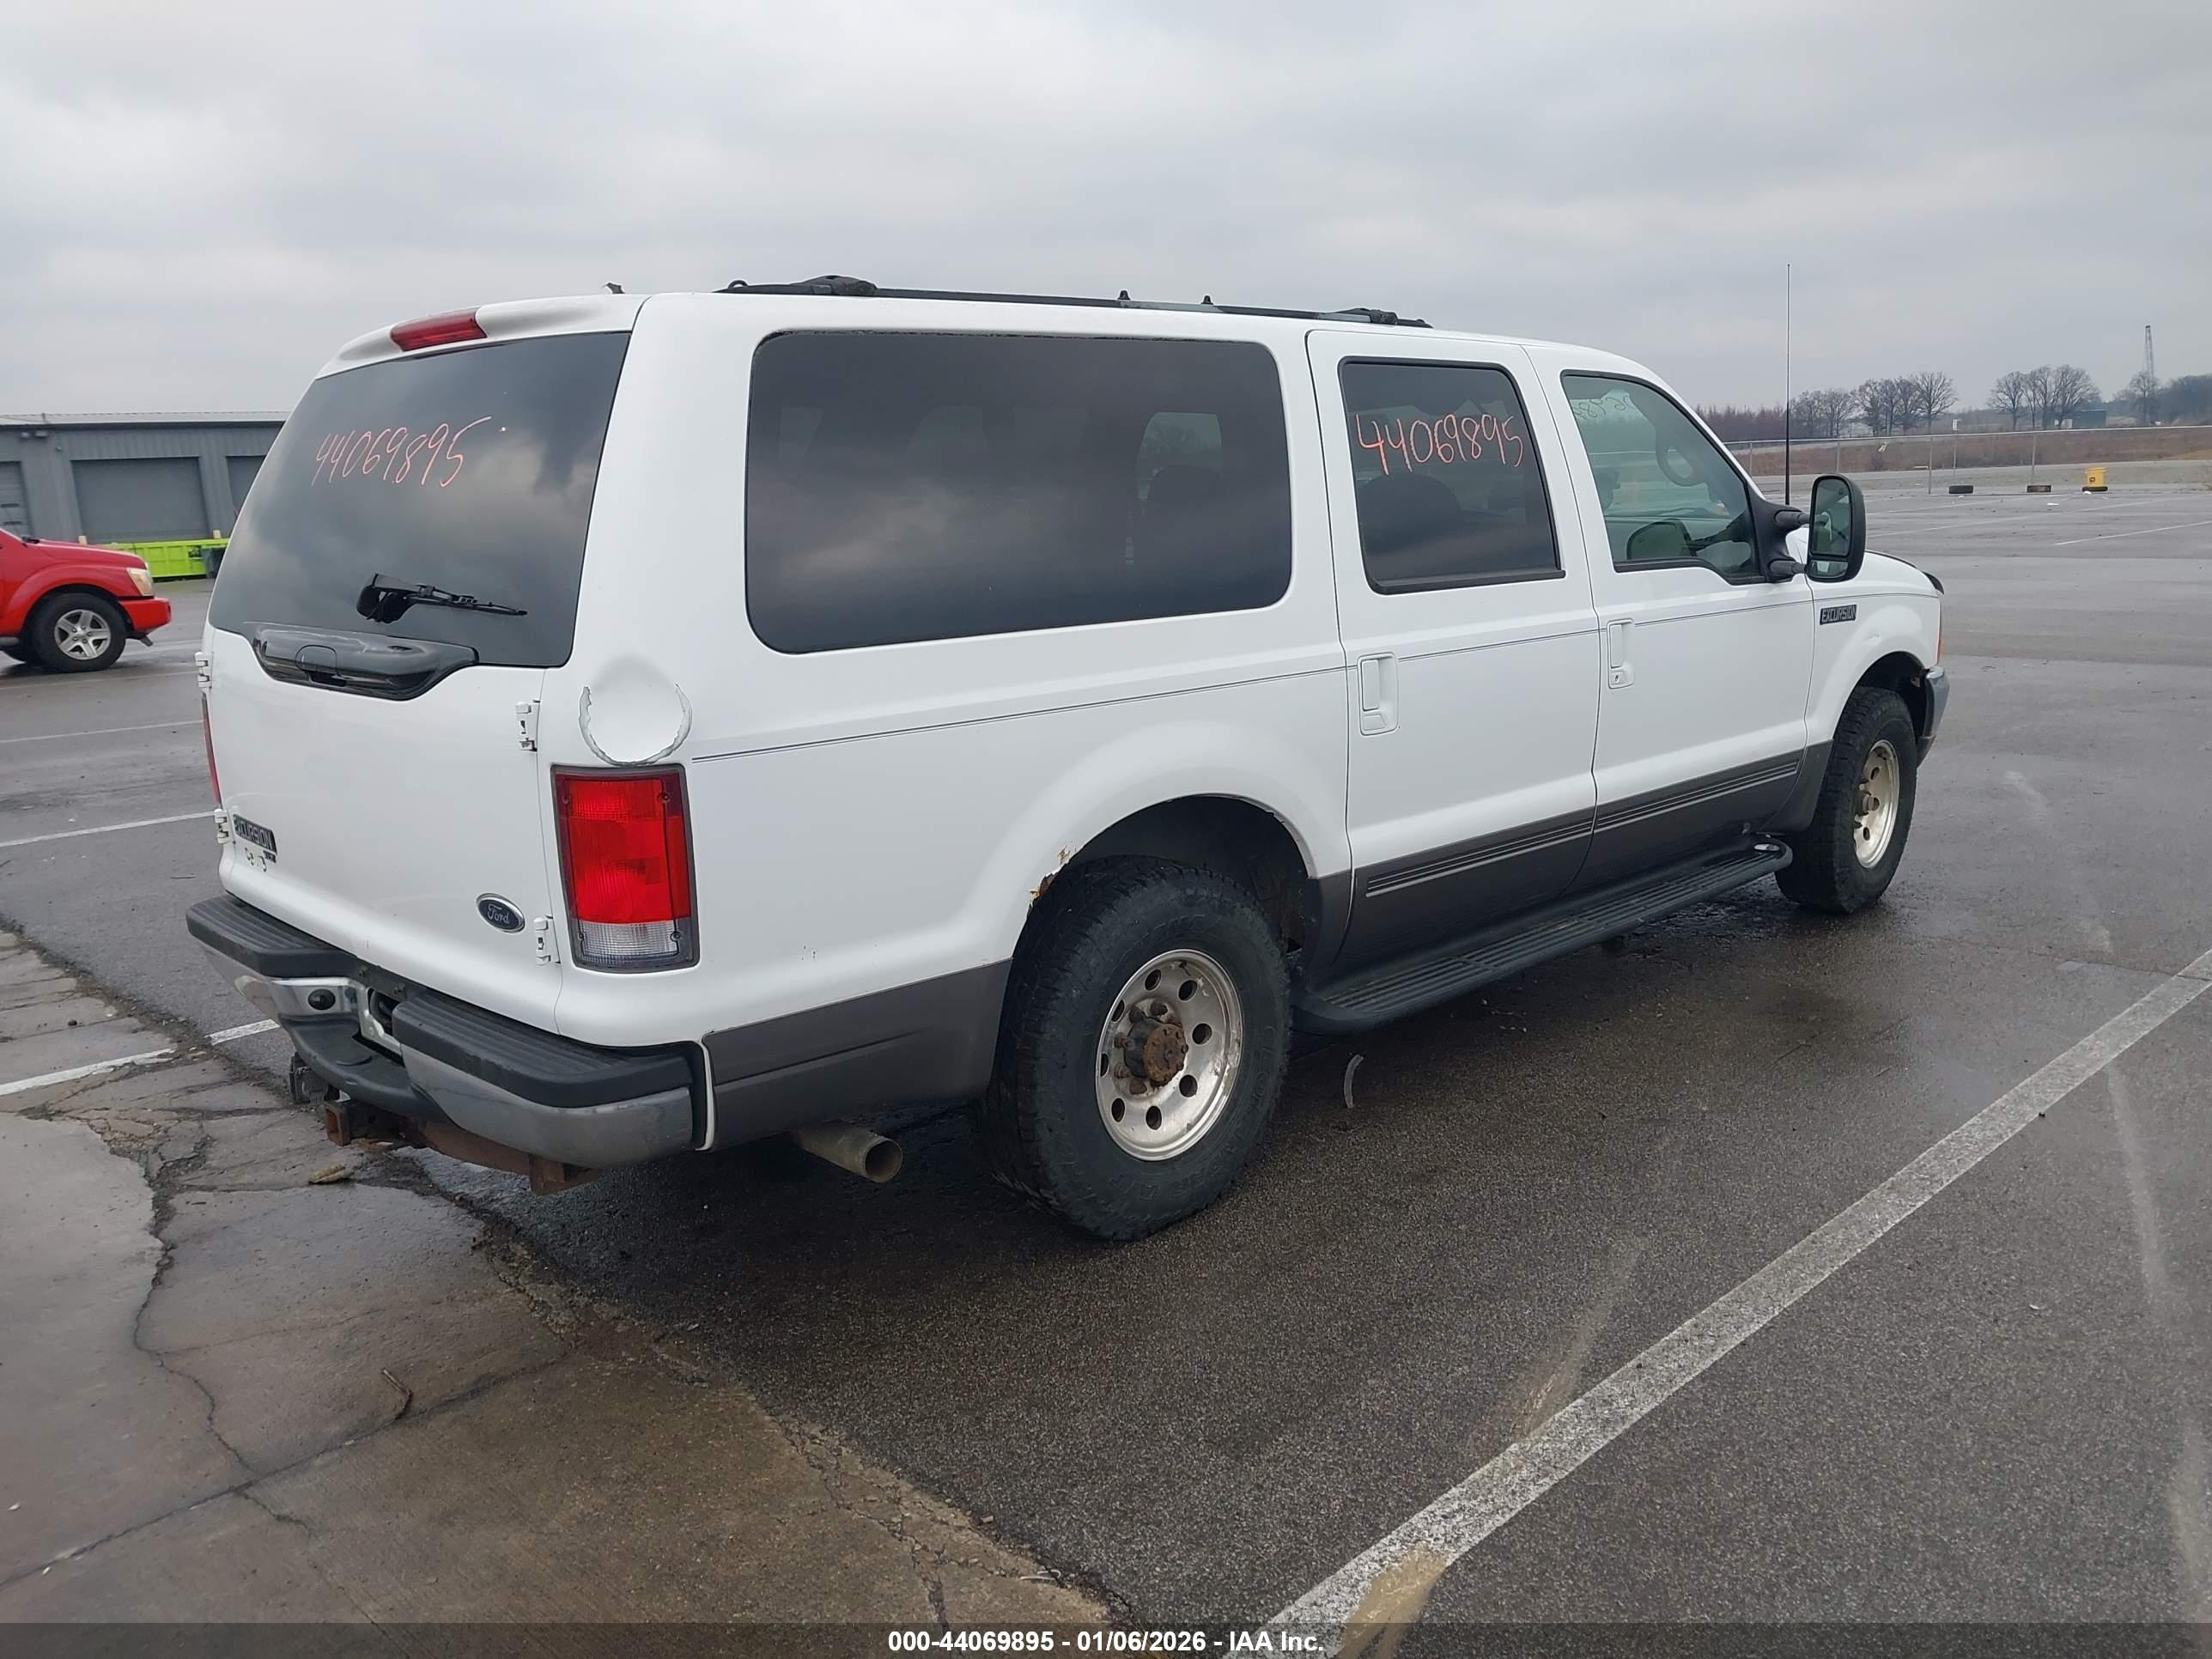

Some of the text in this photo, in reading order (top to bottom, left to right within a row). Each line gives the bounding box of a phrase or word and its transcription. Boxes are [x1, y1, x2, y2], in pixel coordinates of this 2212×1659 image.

[311, 416, 492, 487] 44069895
[1355, 412, 1523, 475] 44069895
[487, 903, 510, 924] Ford
